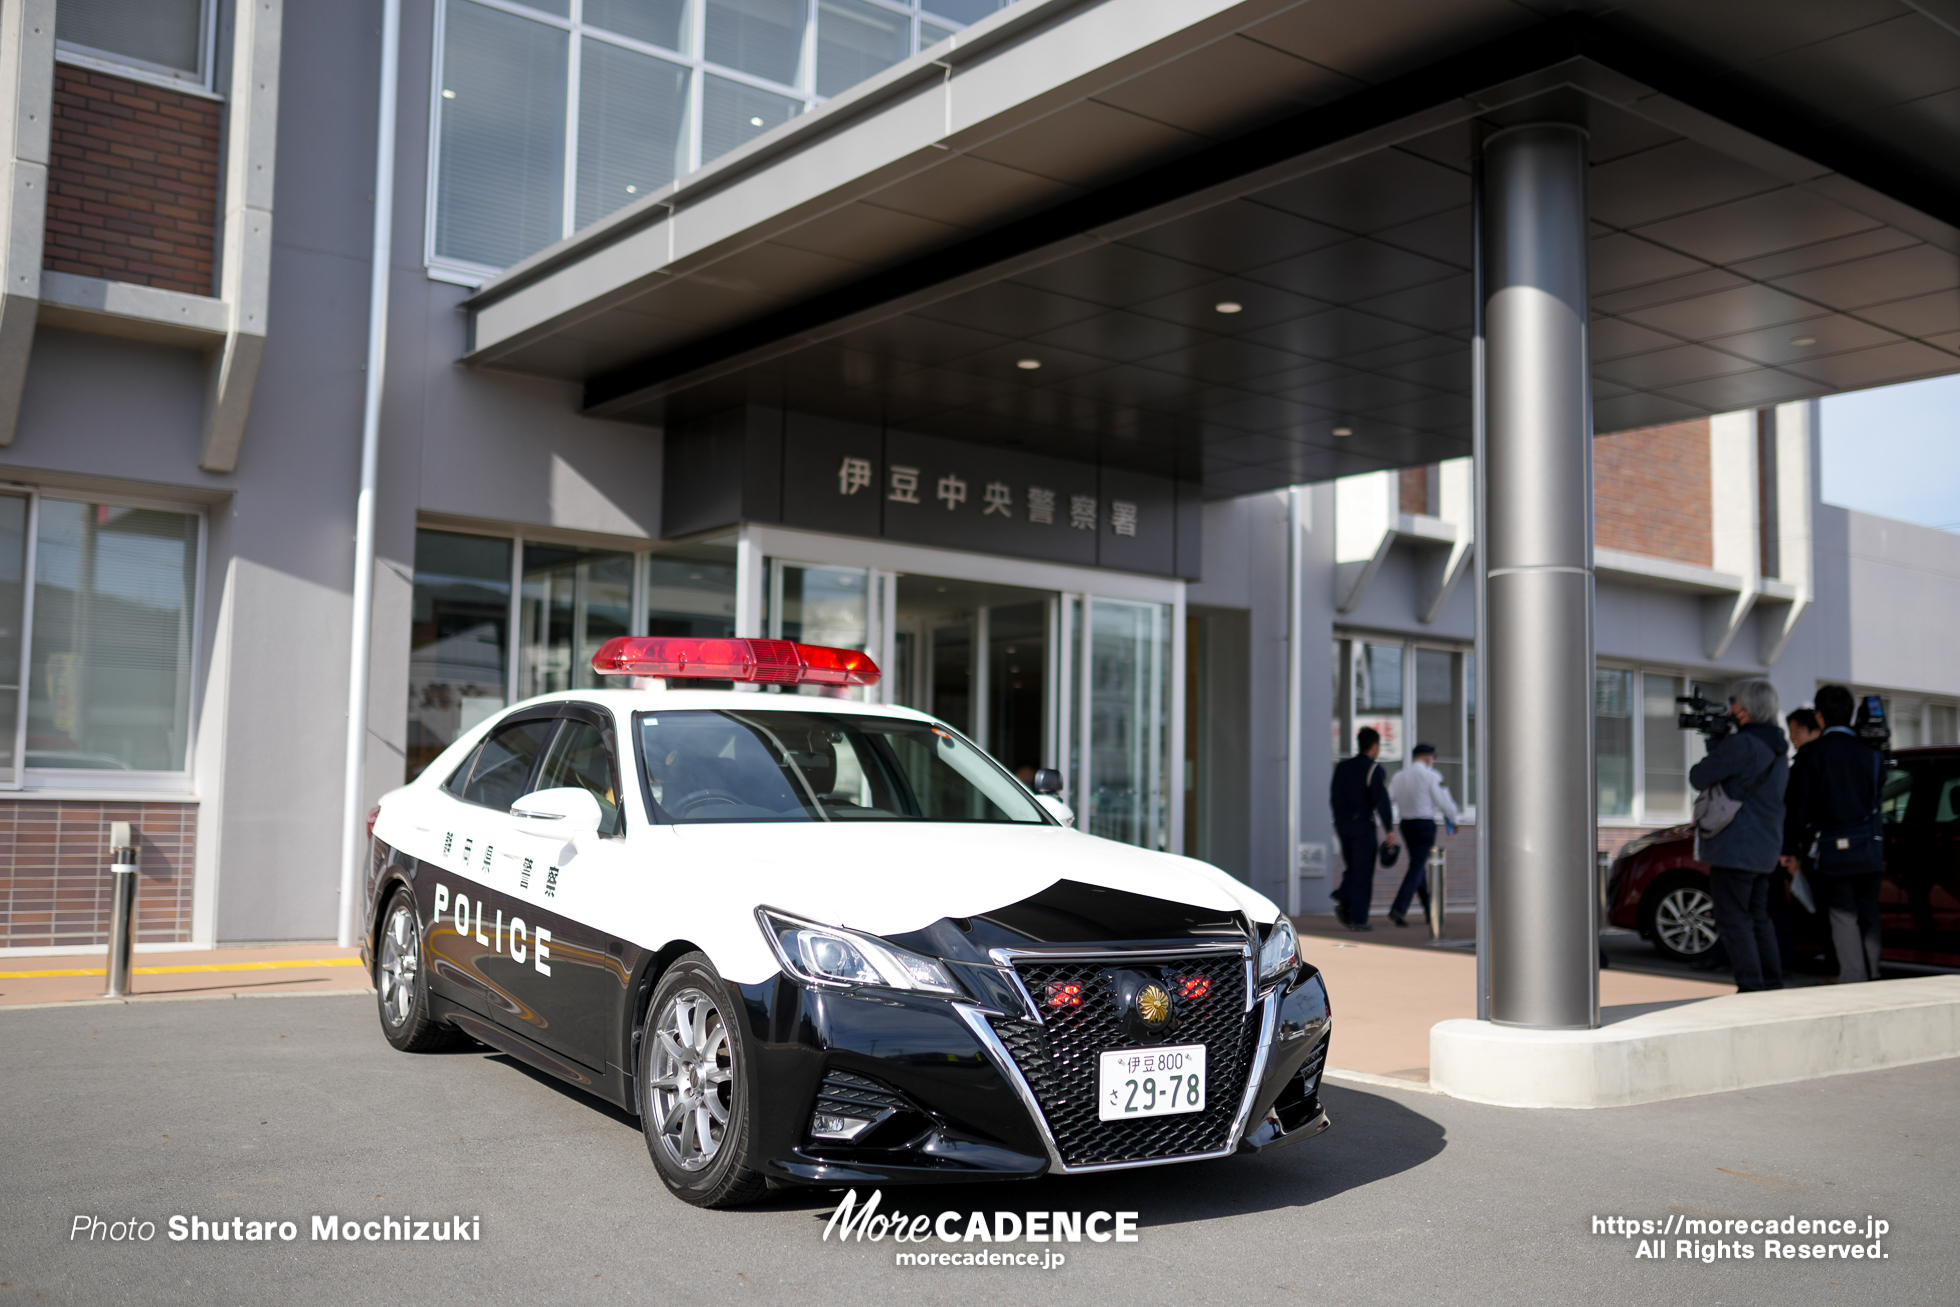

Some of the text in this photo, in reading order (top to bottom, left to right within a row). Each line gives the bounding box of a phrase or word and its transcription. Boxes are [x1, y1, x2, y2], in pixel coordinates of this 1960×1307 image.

[838, 456, 1138, 538] 伊豆中央警察署
[434, 883, 551, 977] POLICE
[1109, 1074, 1200, 1113] さ 29-78
